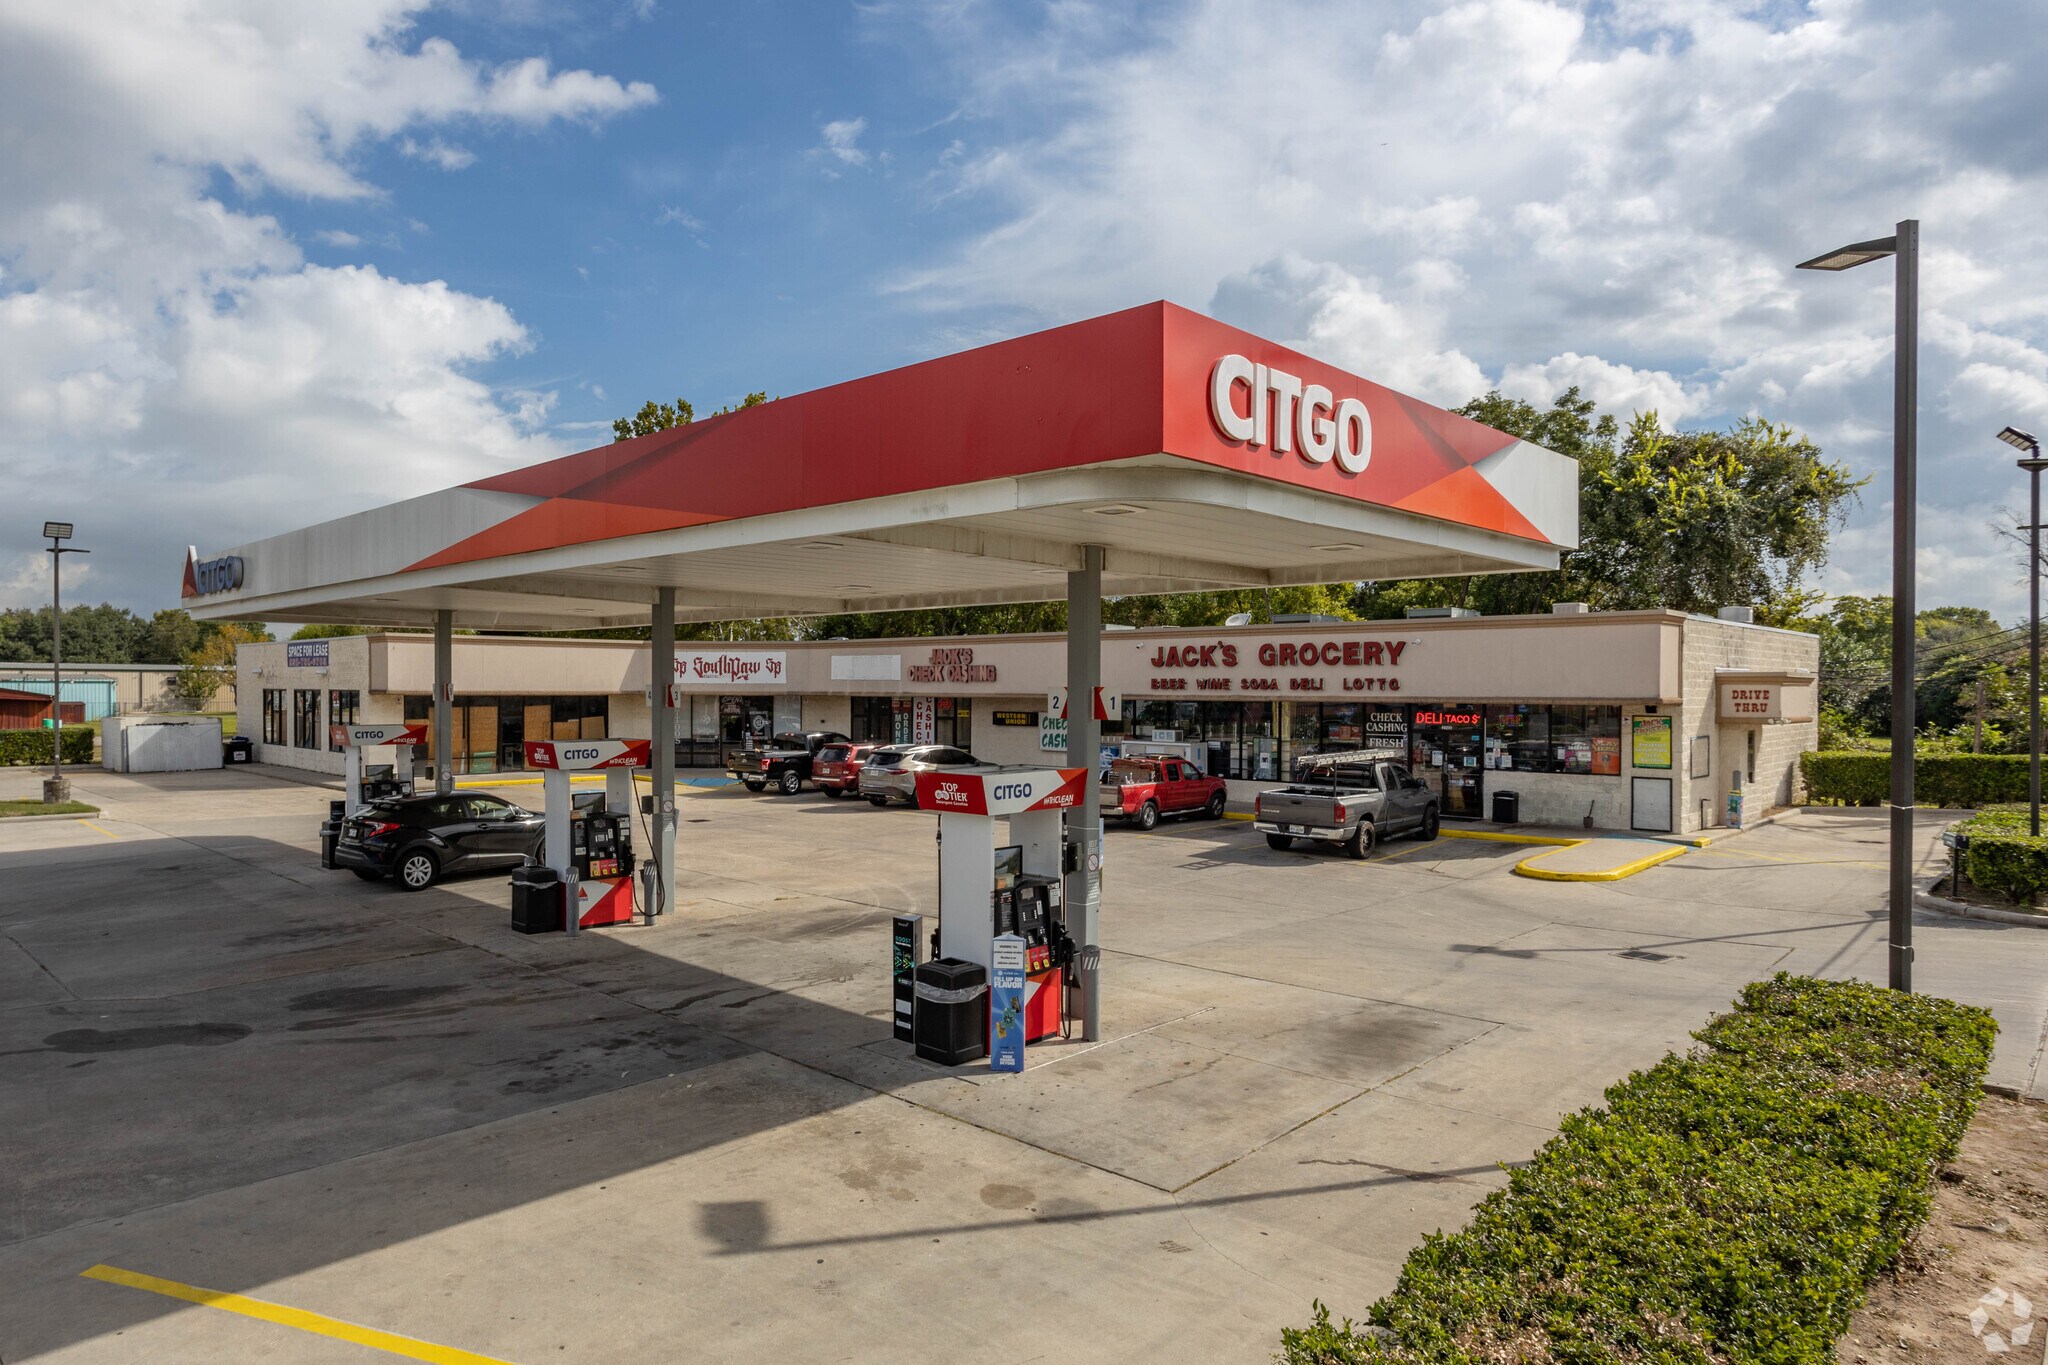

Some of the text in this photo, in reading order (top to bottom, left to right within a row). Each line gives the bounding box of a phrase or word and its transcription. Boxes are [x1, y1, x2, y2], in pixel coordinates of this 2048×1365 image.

[1211, 354, 1372, 474] CITGO
[198, 556, 244, 596] CITGO
[288, 643, 328, 658] SPACE FOR LEASE
[929, 648, 973, 665] JACK'S
[1151, 640, 1406, 667] JACK'S GROCERY
[907, 666, 945, 682] CHECK
[1151, 678, 1400, 690] BEER WINE SODA DELI LOTTO
[674, 691, 679, 701] 3
[1732, 690, 1770, 700] DRIVE
[1052, 696, 1059, 709] 2
[1110, 696, 1116, 710] 1
[1734, 703, 1768, 713] THRU
[1370, 712, 1403, 722] CHECK
[1416, 712, 1443, 725] DELI
[1366, 723, 1408, 732] CASHING
[355, 730, 384, 739] CITGO
[1153, 731, 1174, 740] ICE
[1369, 738, 1404, 748] FRESH
[564, 748, 599, 760] CITGO
[941, 782, 958, 792] TOP
[994, 783, 1032, 800] CITGO
[949, 791, 968, 802] TIER
[994, 981, 1022, 989] FLAVOR
